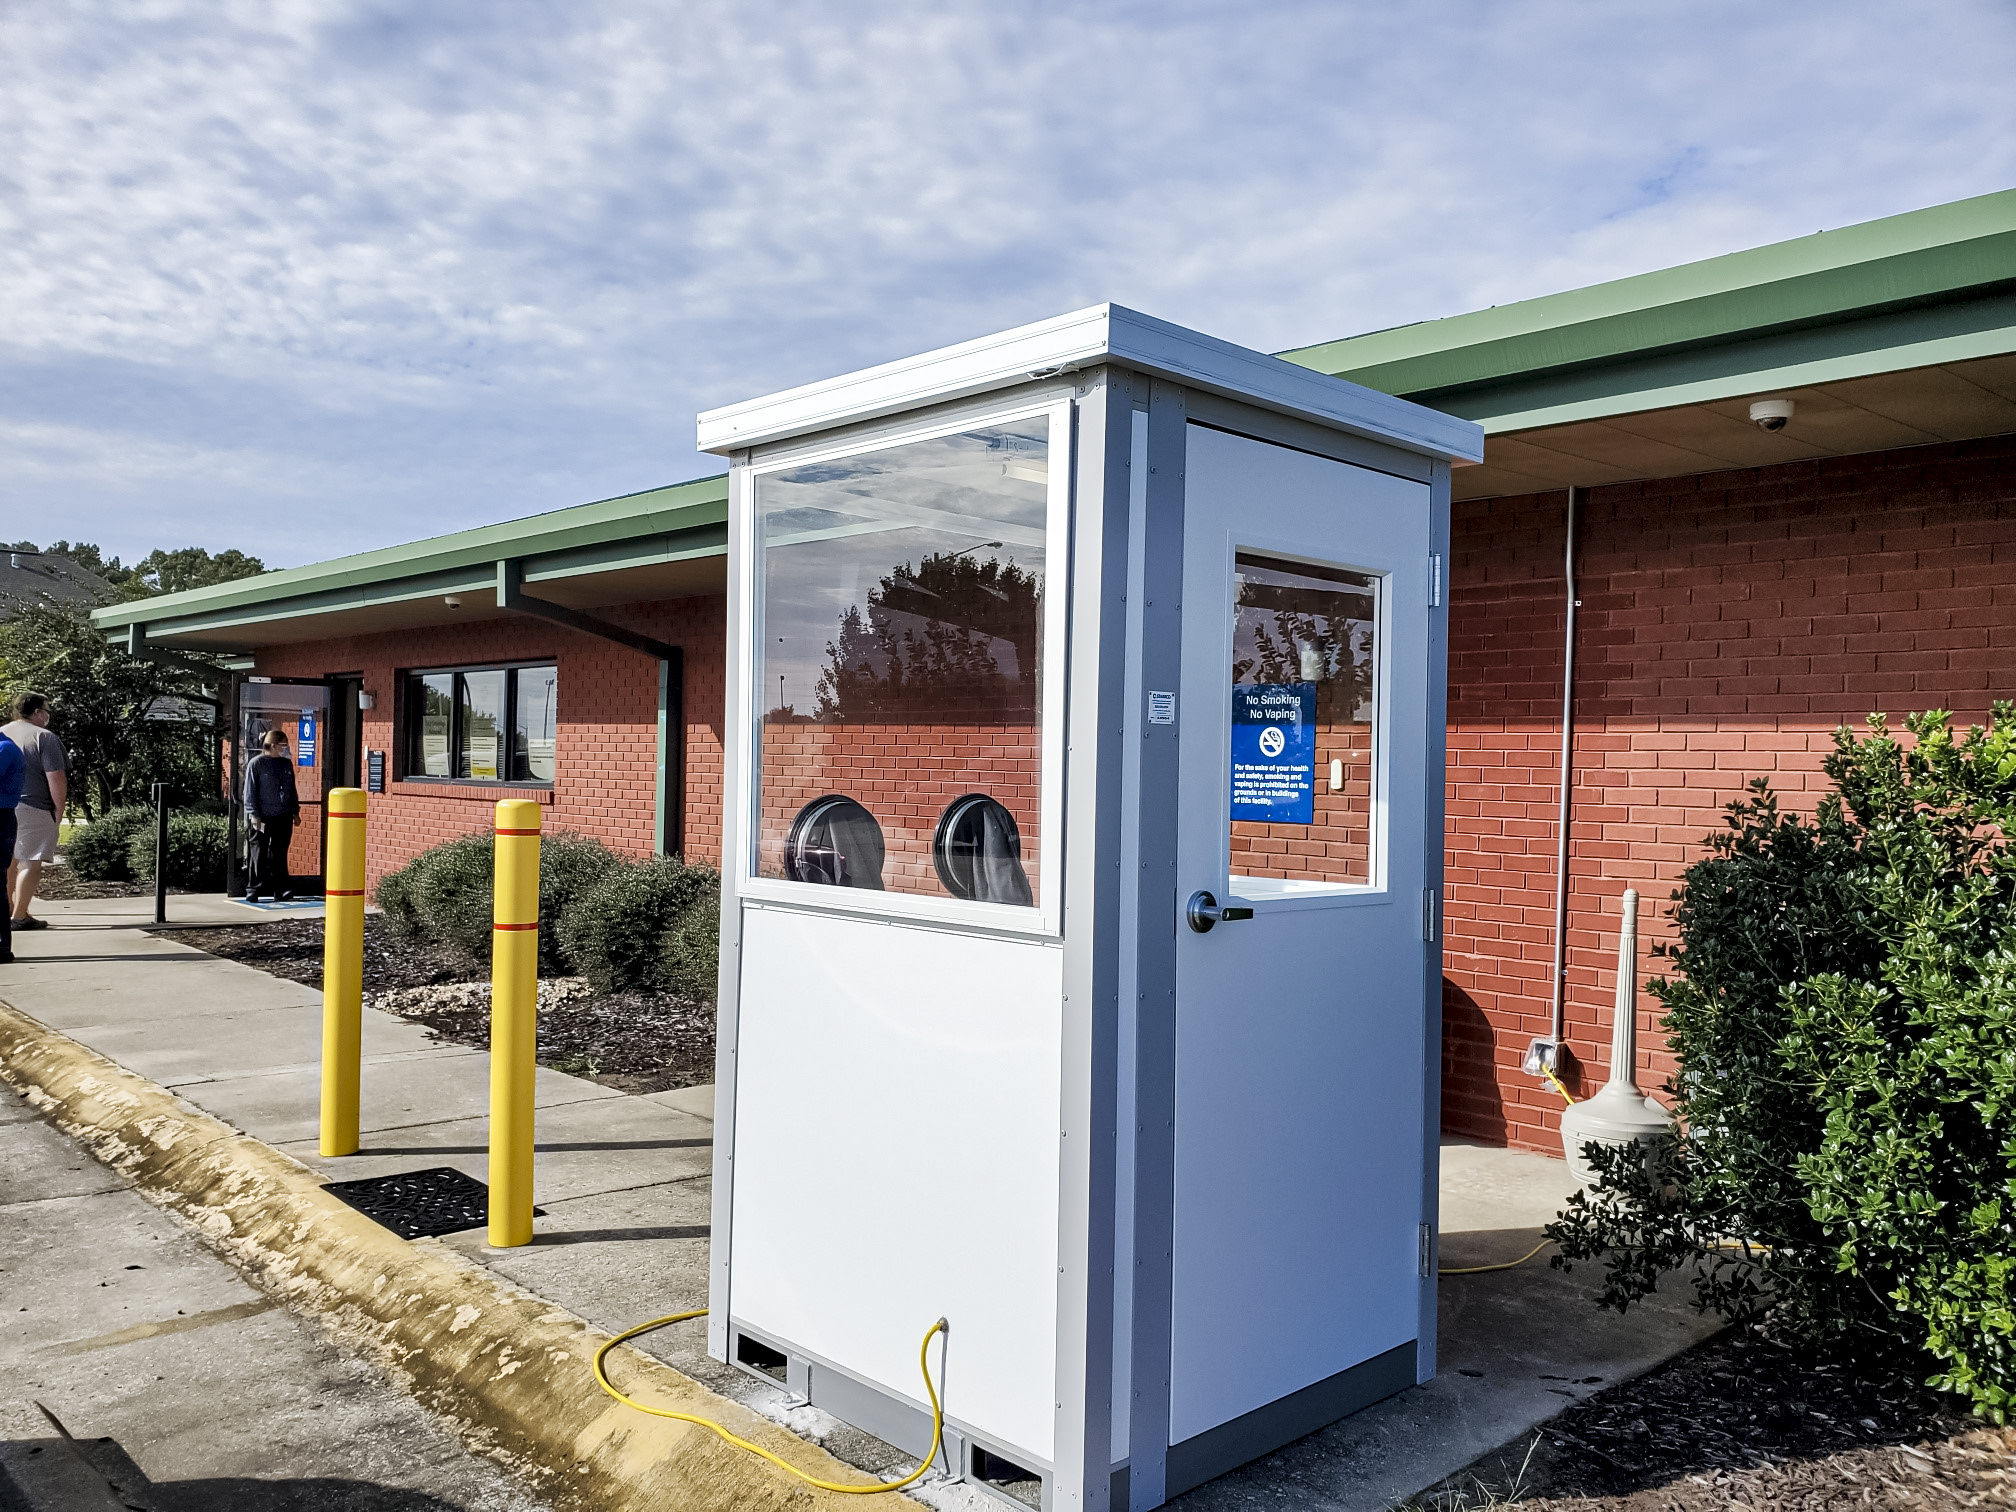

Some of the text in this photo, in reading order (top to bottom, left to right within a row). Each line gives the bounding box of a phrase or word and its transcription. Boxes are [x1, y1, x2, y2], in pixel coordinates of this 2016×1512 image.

[1246, 694, 1301, 706] No Smoking
[1250, 708, 1296, 721] No Vaping
[1234, 763, 1244, 771] For
[1290, 764, 1309, 772] health
